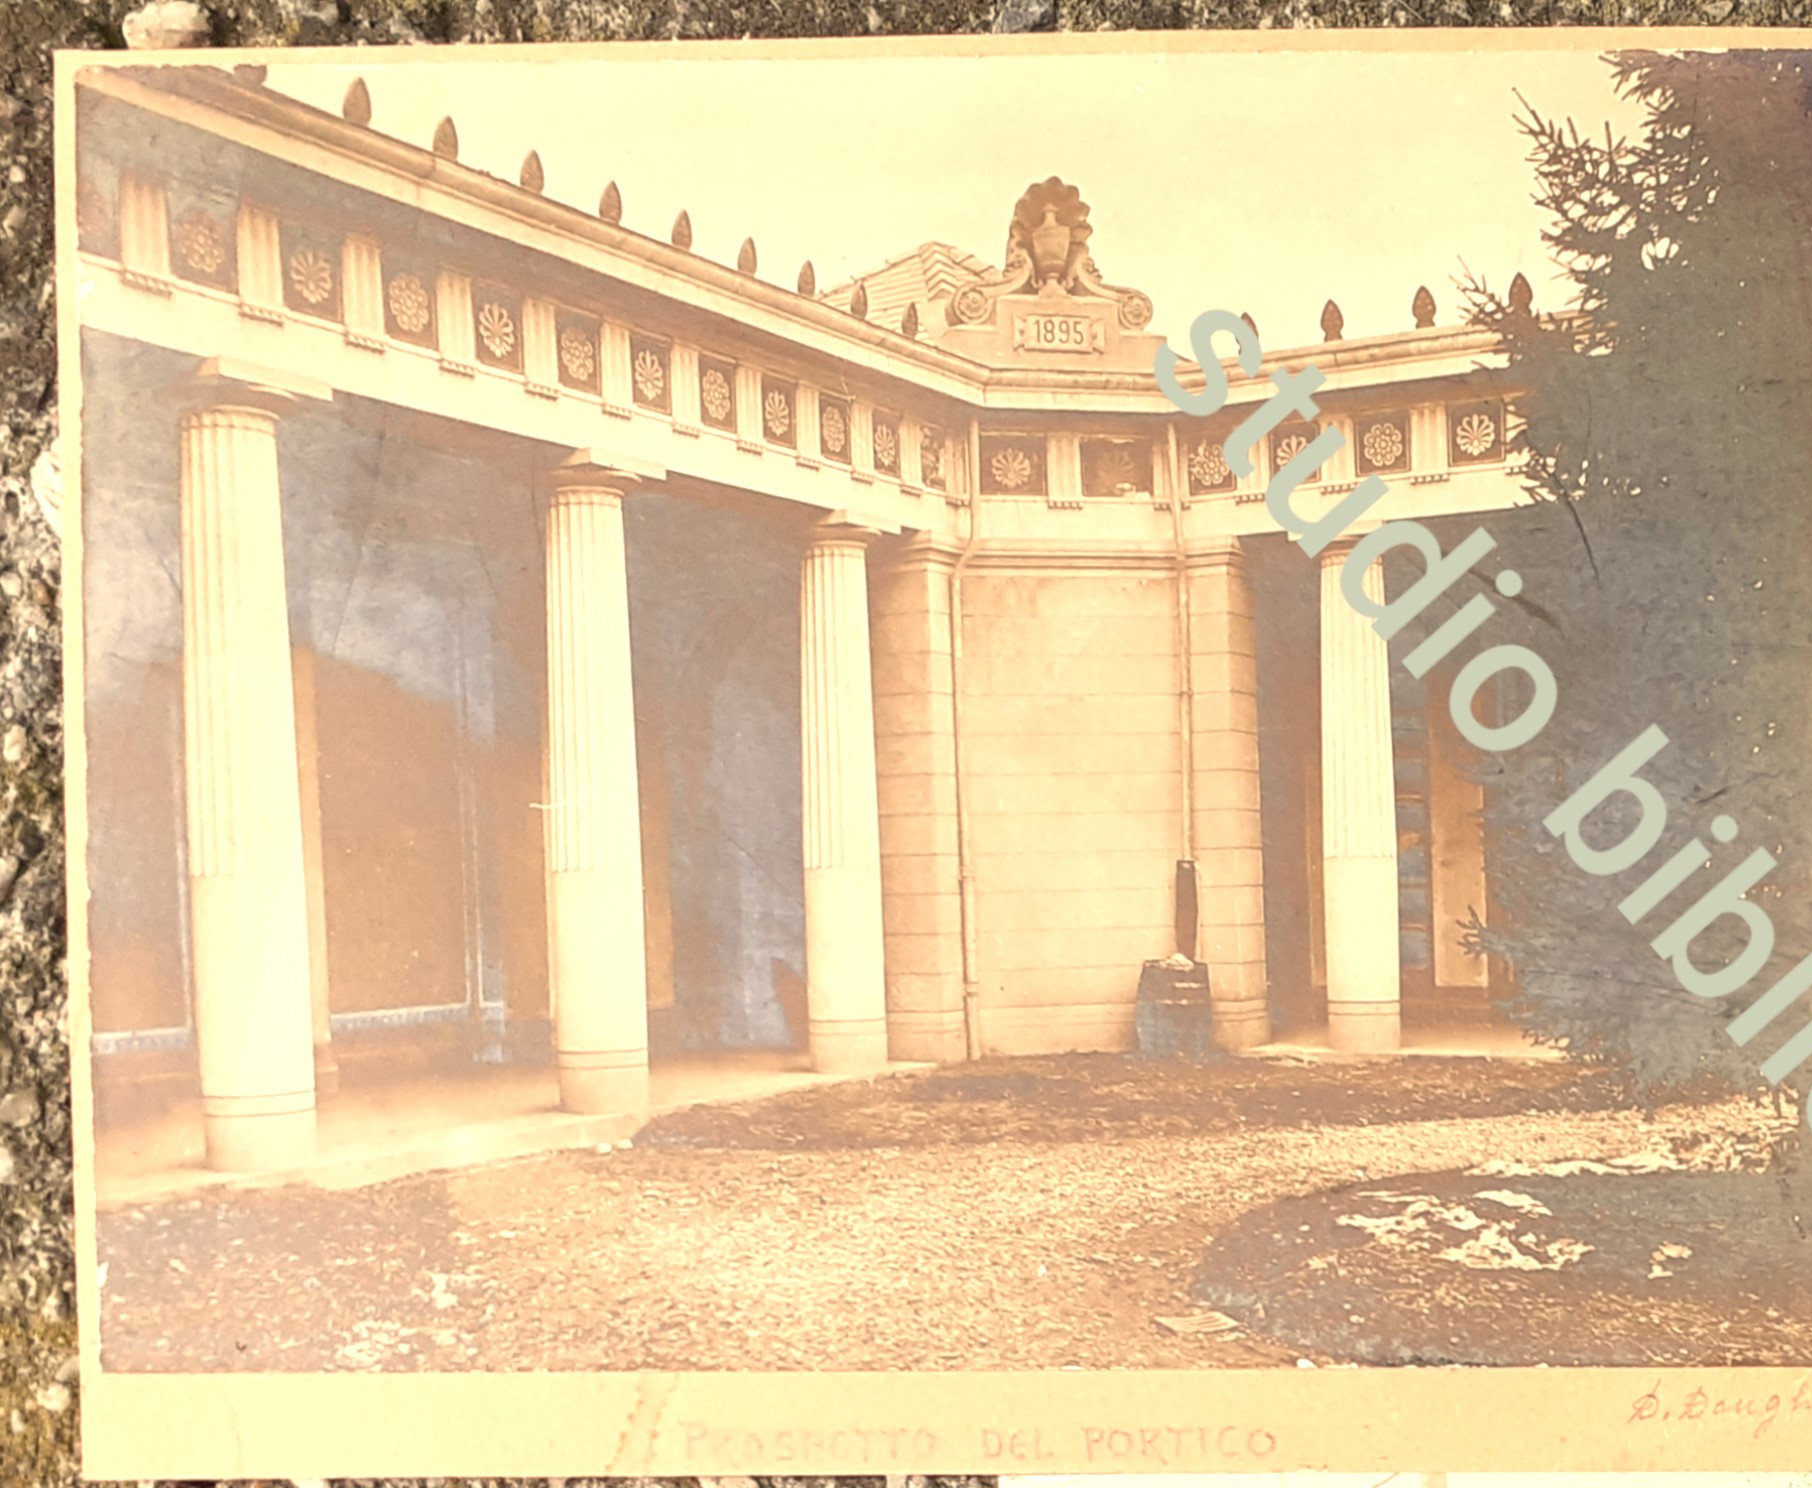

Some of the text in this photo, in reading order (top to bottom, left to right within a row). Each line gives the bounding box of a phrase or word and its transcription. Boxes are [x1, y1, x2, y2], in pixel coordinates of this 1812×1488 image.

[1033, 319, 1085, 345] 1895
[981, 1427, 1055, 1461] DEL
[1080, 1425, 1278, 1465] PORTICO
